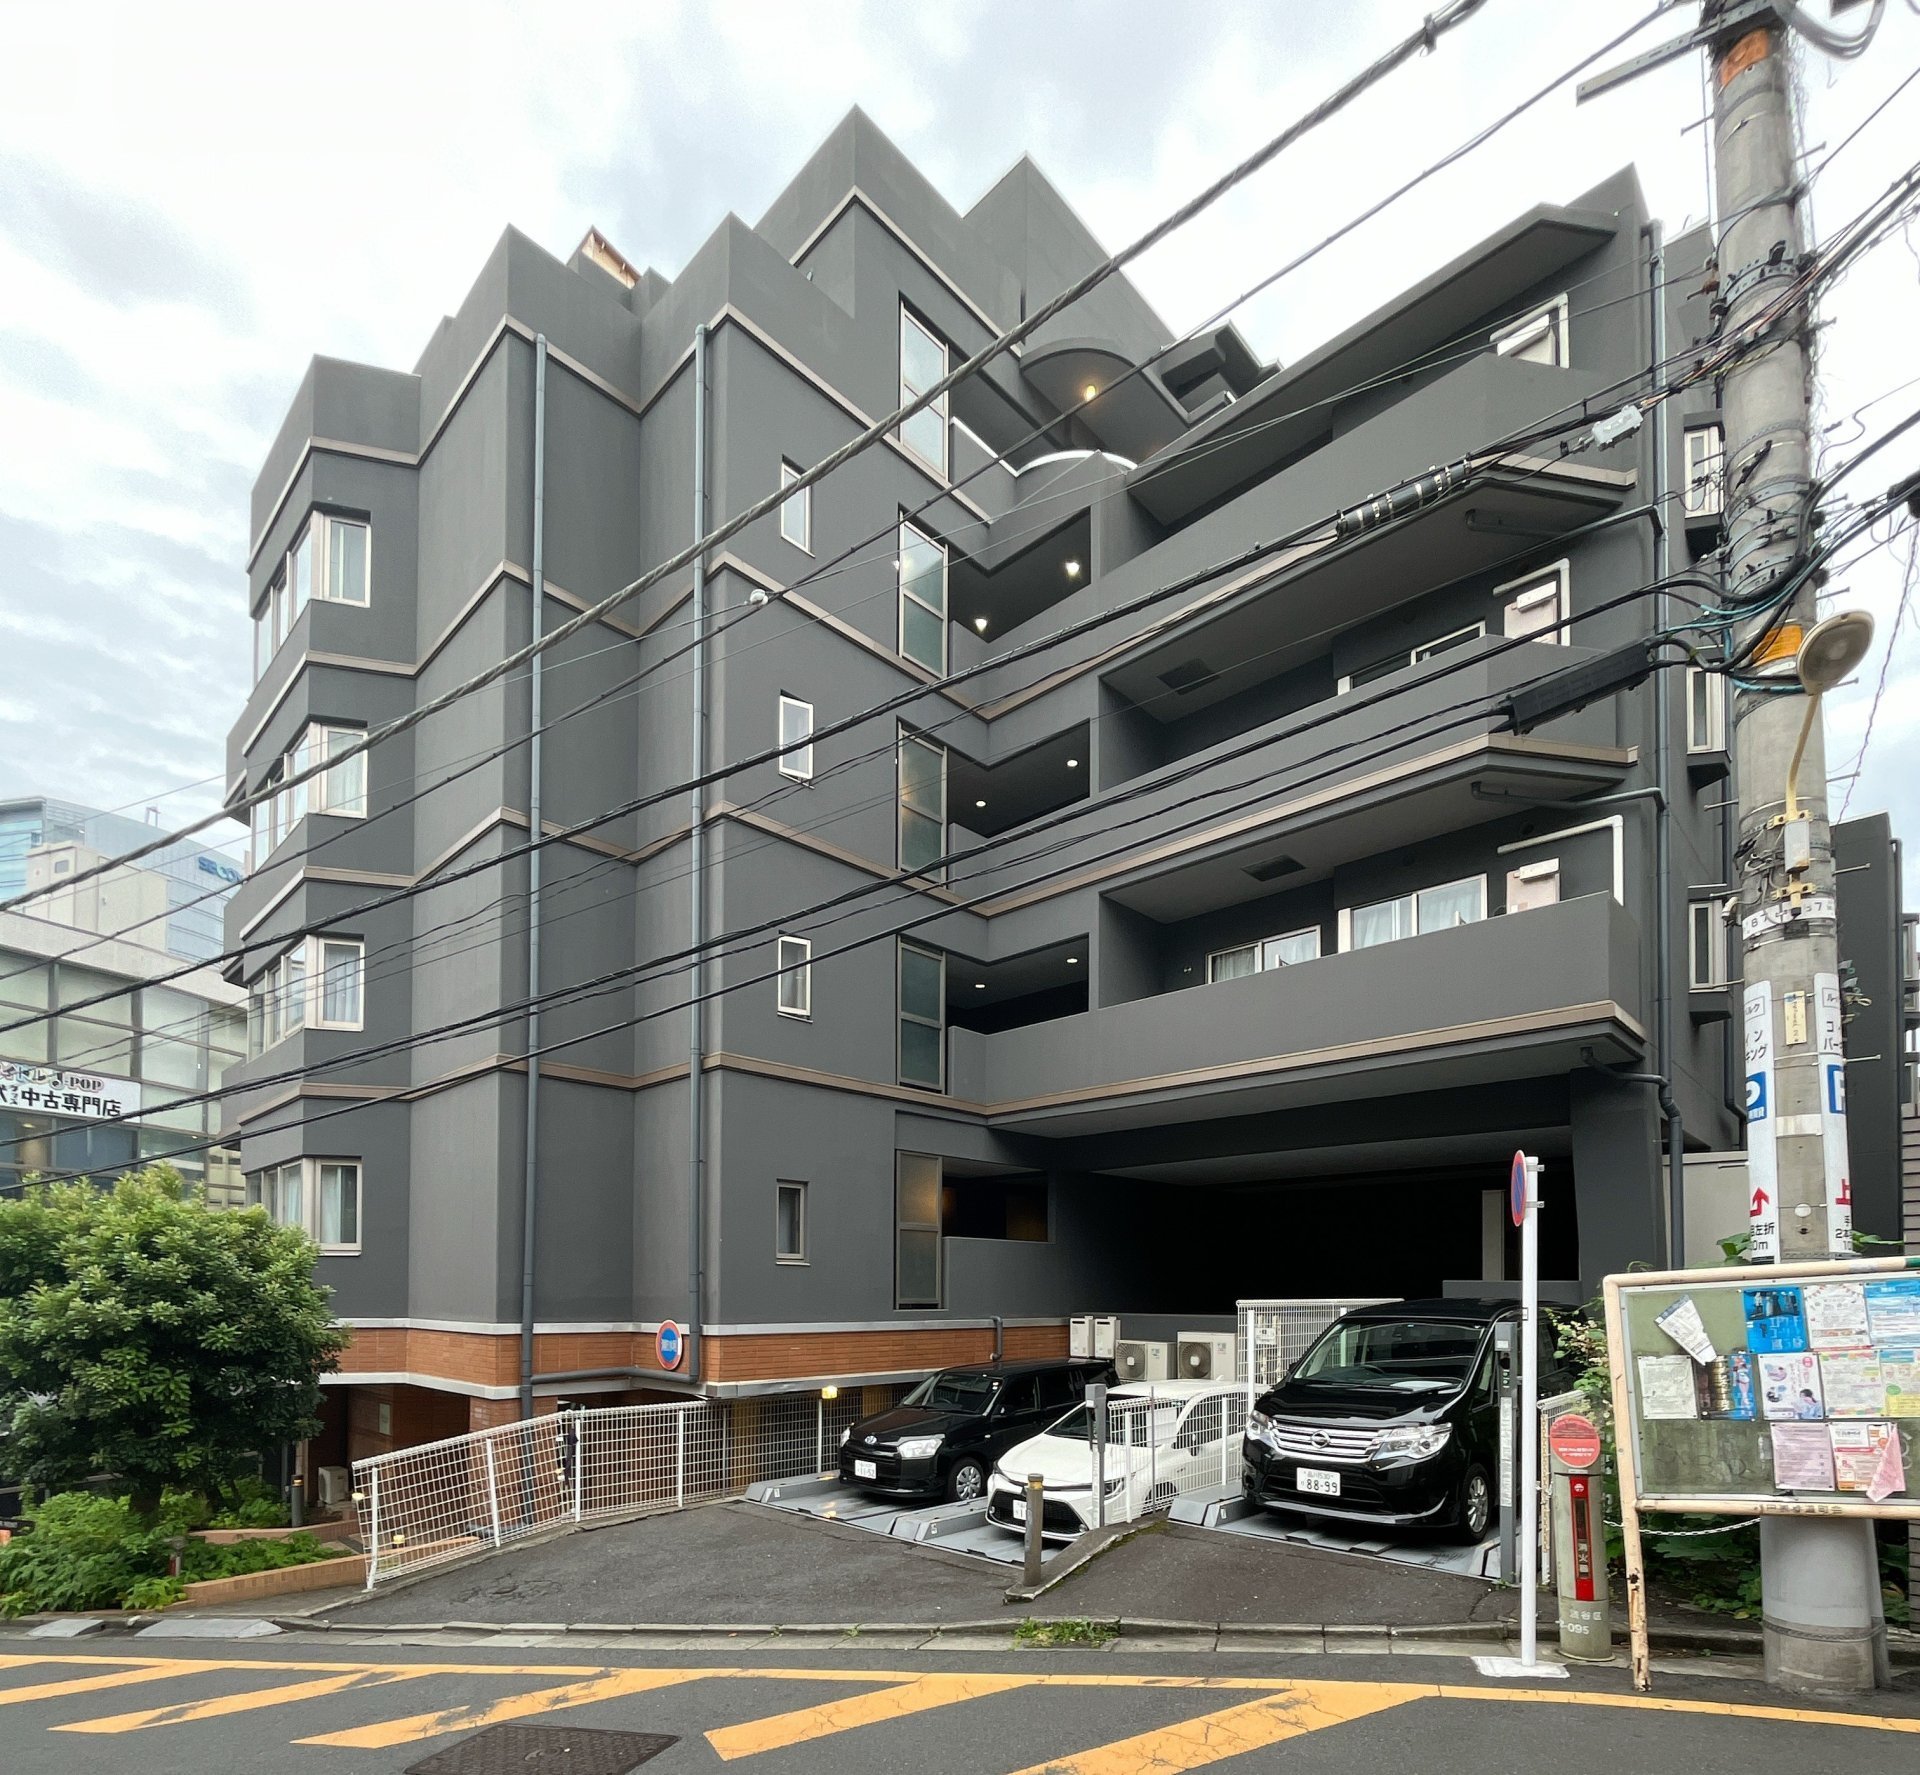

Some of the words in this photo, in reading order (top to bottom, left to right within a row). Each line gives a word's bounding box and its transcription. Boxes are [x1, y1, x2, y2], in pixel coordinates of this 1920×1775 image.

[198, 857, 242, 884] SECO
[21, 1087, 122, 1117] 中古専門店
[1307, 1478, 1338, 1494] 88-99
